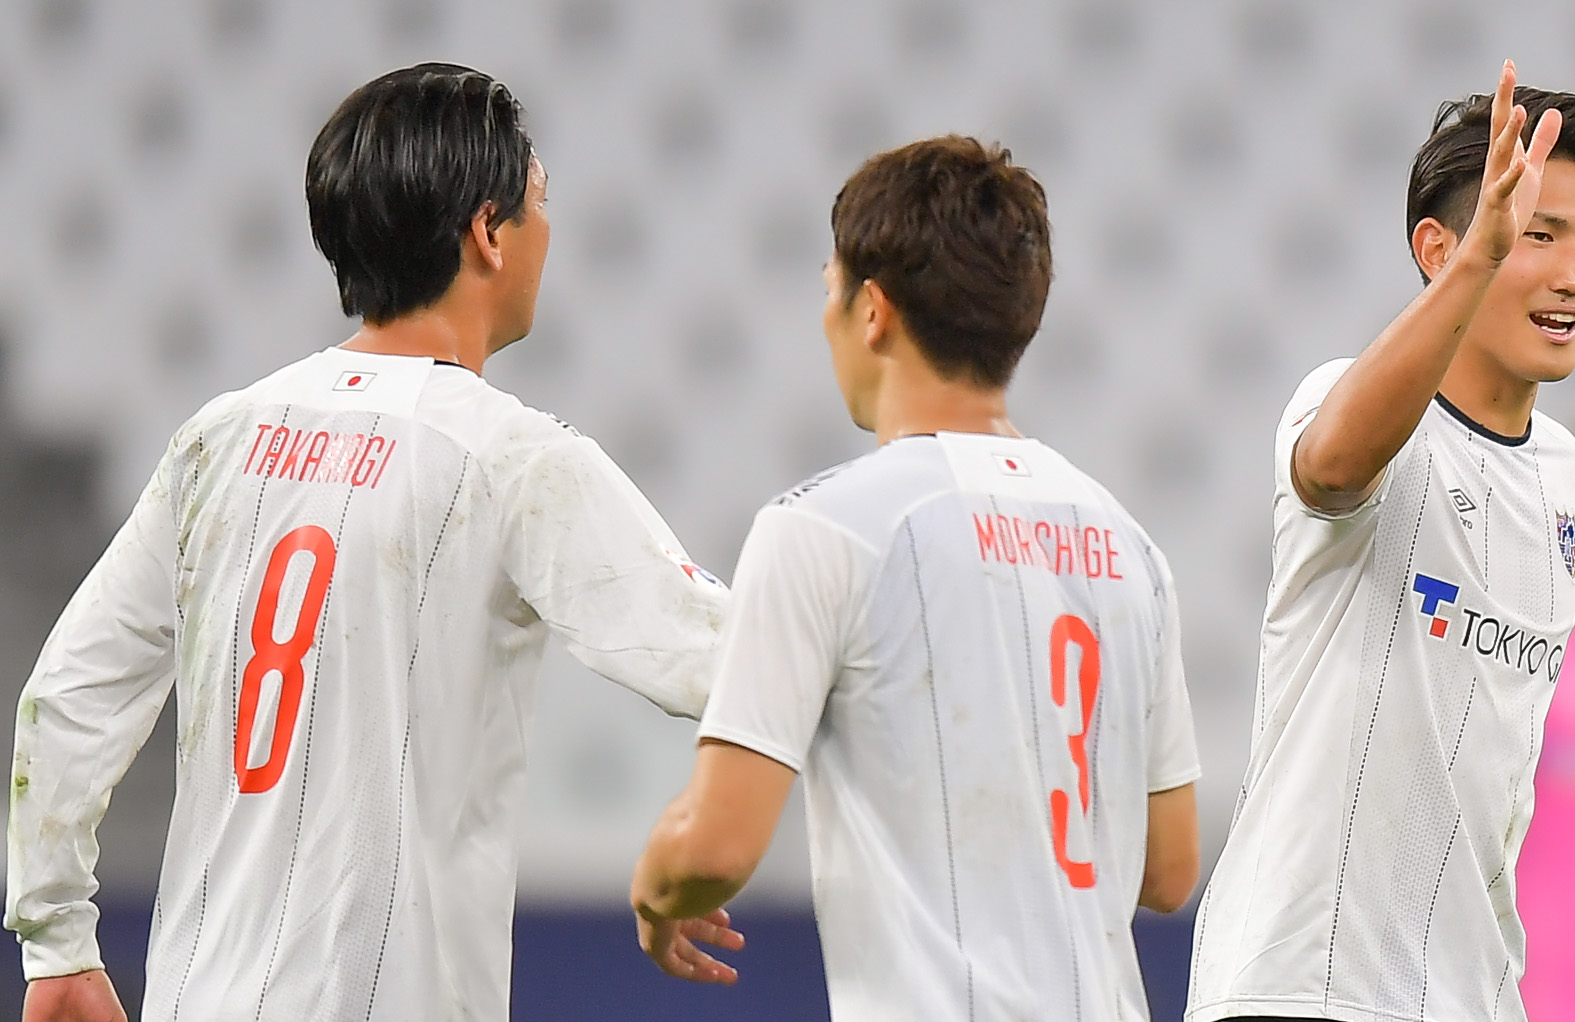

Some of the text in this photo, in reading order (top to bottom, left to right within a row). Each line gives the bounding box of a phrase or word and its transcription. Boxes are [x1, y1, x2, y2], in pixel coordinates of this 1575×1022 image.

[973, 512, 1123, 580] MORSHIGE
[234, 525, 337, 795] 8
[1462, 608, 1563, 684] TOKYO G
[1050, 614, 1102, 889] 3
